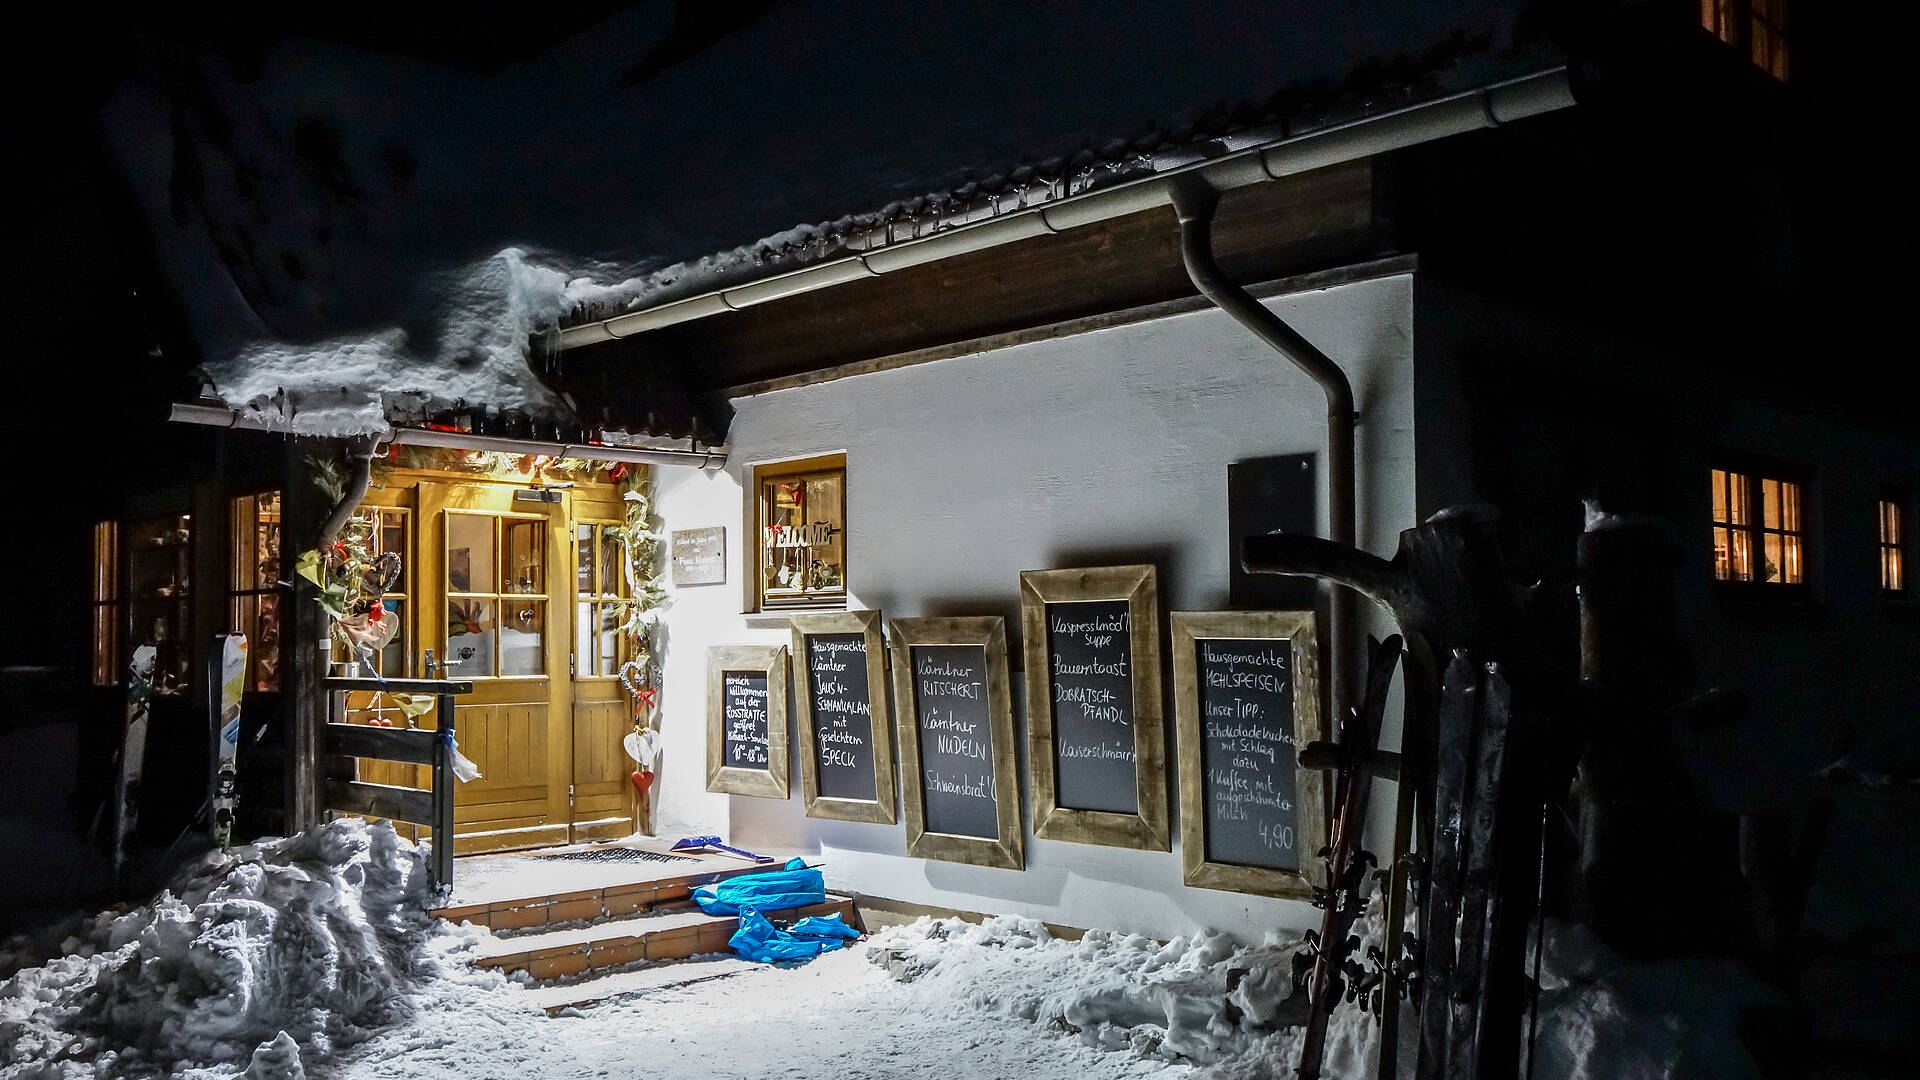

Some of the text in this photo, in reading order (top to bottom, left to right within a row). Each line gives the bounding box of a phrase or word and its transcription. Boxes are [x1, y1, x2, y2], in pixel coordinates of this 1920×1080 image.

[812, 638, 866, 658] Hausgemachte
[1203, 643, 1286, 672] Hausgemachte
[811, 655, 846, 672] Kärntner
[917, 655, 973, 678] Kärntner
[1053, 653, 1127, 677] Bauerntoast
[923, 681, 981, 700] RITSCHERT
[1204, 669, 1285, 694] MEHLSPEISEN
[735, 696, 761, 709] auf der
[1080, 702, 1128, 725] PFANDL
[1205, 700, 1234, 717] Unser
[833, 715, 847, 727] mit
[922, 707, 977, 735] Kärntner
[818, 727, 863, 749] Geselchtem
[937, 734, 986, 761] NUDELN
[822, 747, 856, 768] SPECK
[1221, 738, 1275, 763] mit Schlag
[1232, 754, 1259, 771] dazu
[1208, 768, 1273, 794] 1 Kaffee mit
[1215, 788, 1293, 811] aufgeschäumter
[1216, 803, 1248, 820] Milch
[1258, 820, 1293, 849] 4,90
